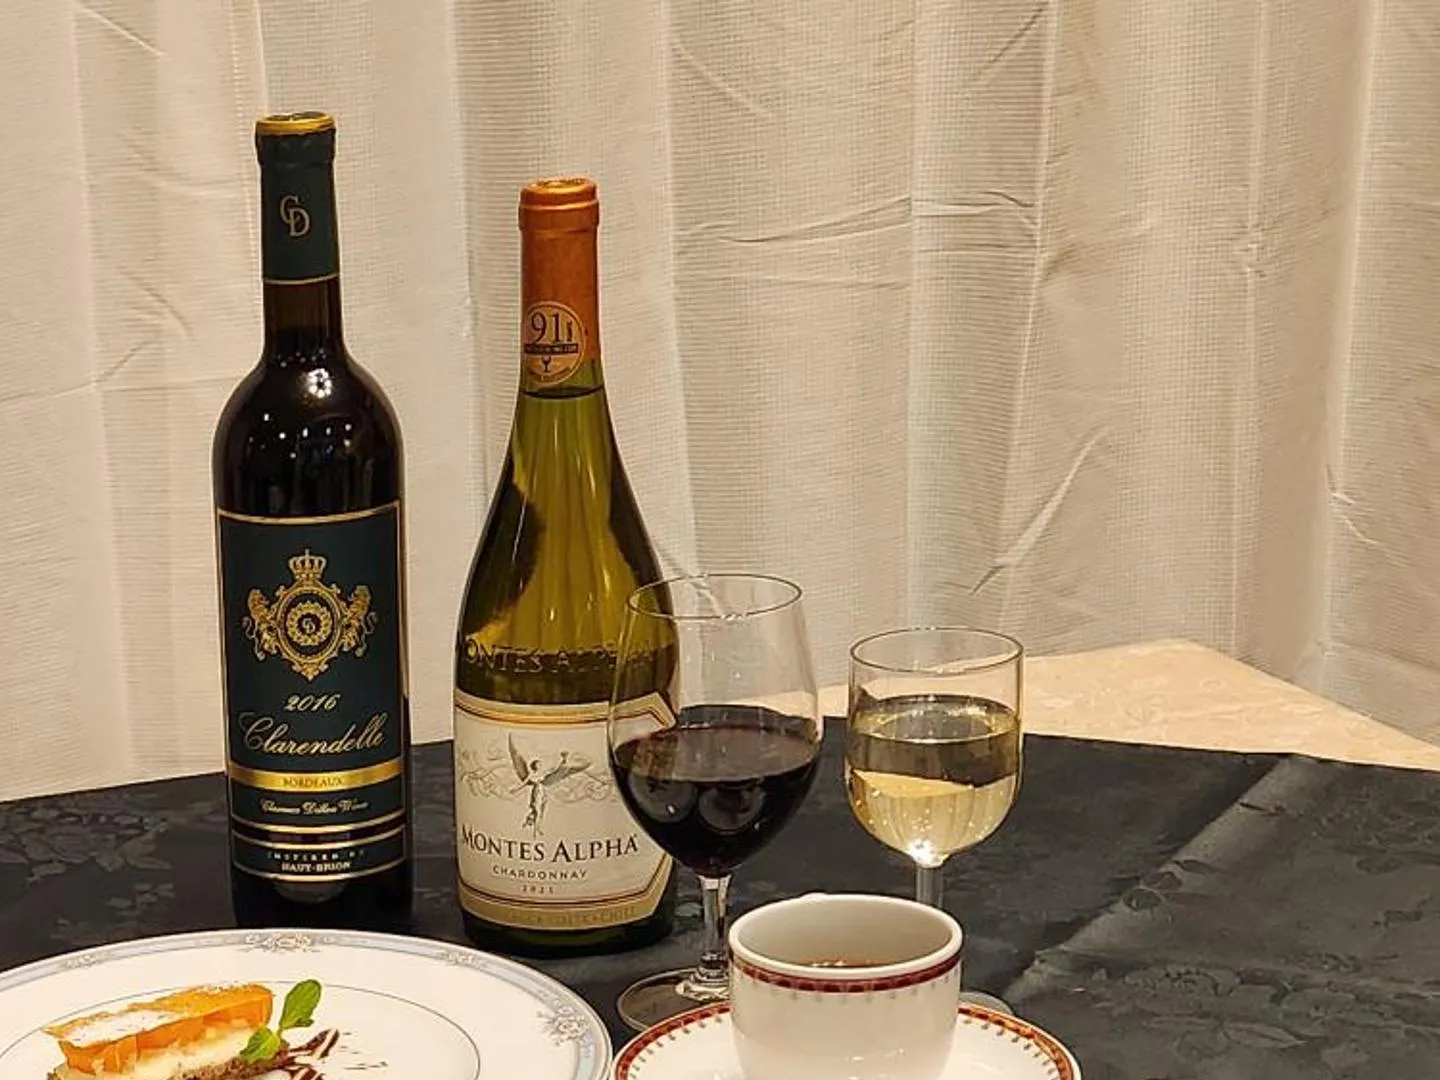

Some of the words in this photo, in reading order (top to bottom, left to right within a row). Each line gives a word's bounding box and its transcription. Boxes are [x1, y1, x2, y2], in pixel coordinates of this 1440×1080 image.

[459, 636, 544, 673] ONTES
[284, 693, 341, 711] 2016
[238, 712, 388, 755] Clarendelle
[283, 776, 344, 788] BORDEAUX
[462, 824, 544, 862] MONTES
[551, 838, 639, 863] ALPHA
[281, 861, 352, 873] HAUT-BRION
[492, 864, 588, 880] CHARDONNAY
